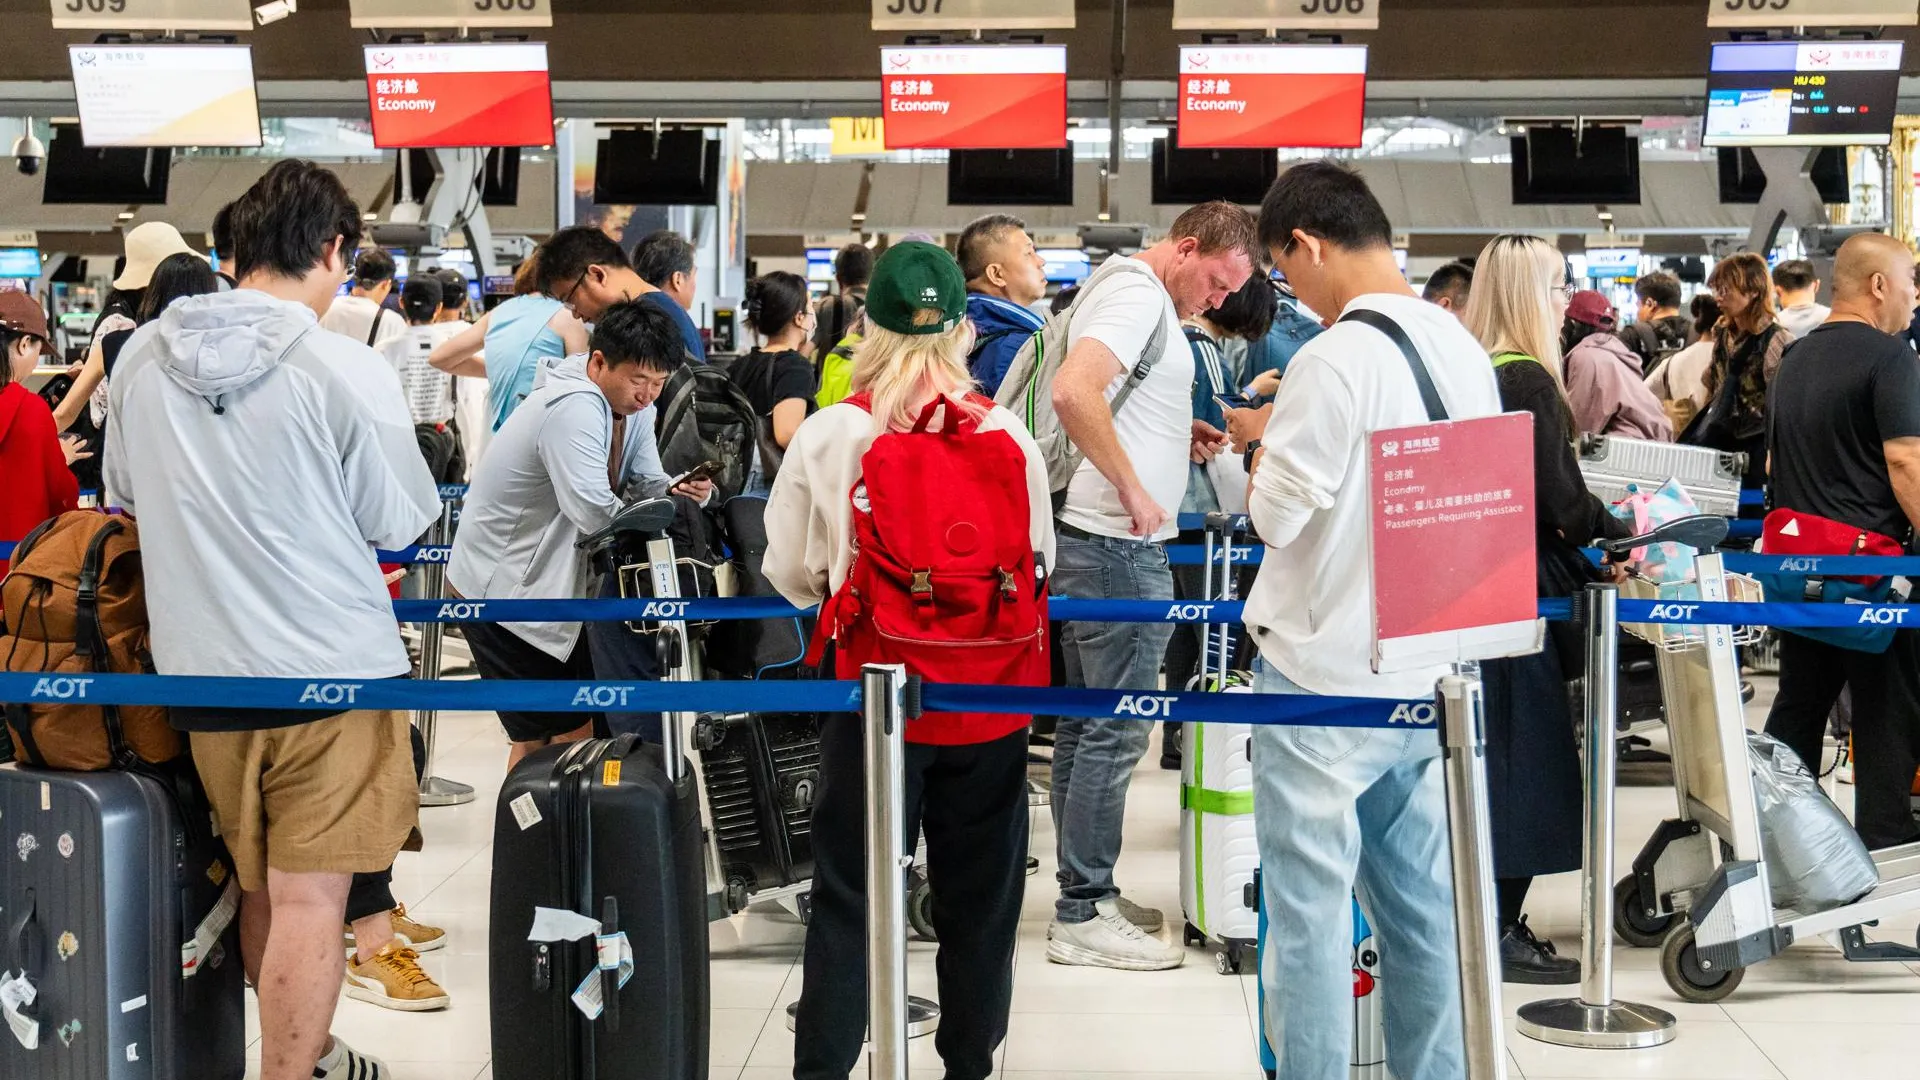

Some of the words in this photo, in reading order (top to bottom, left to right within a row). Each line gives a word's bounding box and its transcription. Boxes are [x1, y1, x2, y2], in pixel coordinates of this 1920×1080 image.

[376, 79, 419, 94] 经济舱
[890, 80, 933, 95] 经济舱
[1187, 79, 1231, 95] 经济舱
[377, 97, 436, 113] Economy
[890, 99, 950, 114] Economy
[1187, 97, 1246, 113] Economy
[1384, 468, 1414, 482] 经济舱
[440, 486, 465, 496] AOT
[1384, 485, 1425, 497] Economy
[1385, 515, 1437, 529] Passengers
[1438, 510, 1482, 523] Requiring
[1483, 504, 1524, 516] Assistace
[415, 547, 452, 561] AOT
[1780, 557, 1822, 571] AOT
[437, 603, 486, 619] AOT
[641, 601, 691, 617] AOT
[1166, 604, 1215, 620] AOT
[1648, 603, 1700, 620] AOT
[1858, 607, 1909, 624] AOT
[31, 678, 94, 698] AOT
[299, 683, 363, 704] AOT
[571, 686, 635, 707] AOT
[1114, 695, 1179, 716] AOT
[1388, 703, 1436, 725] AO
